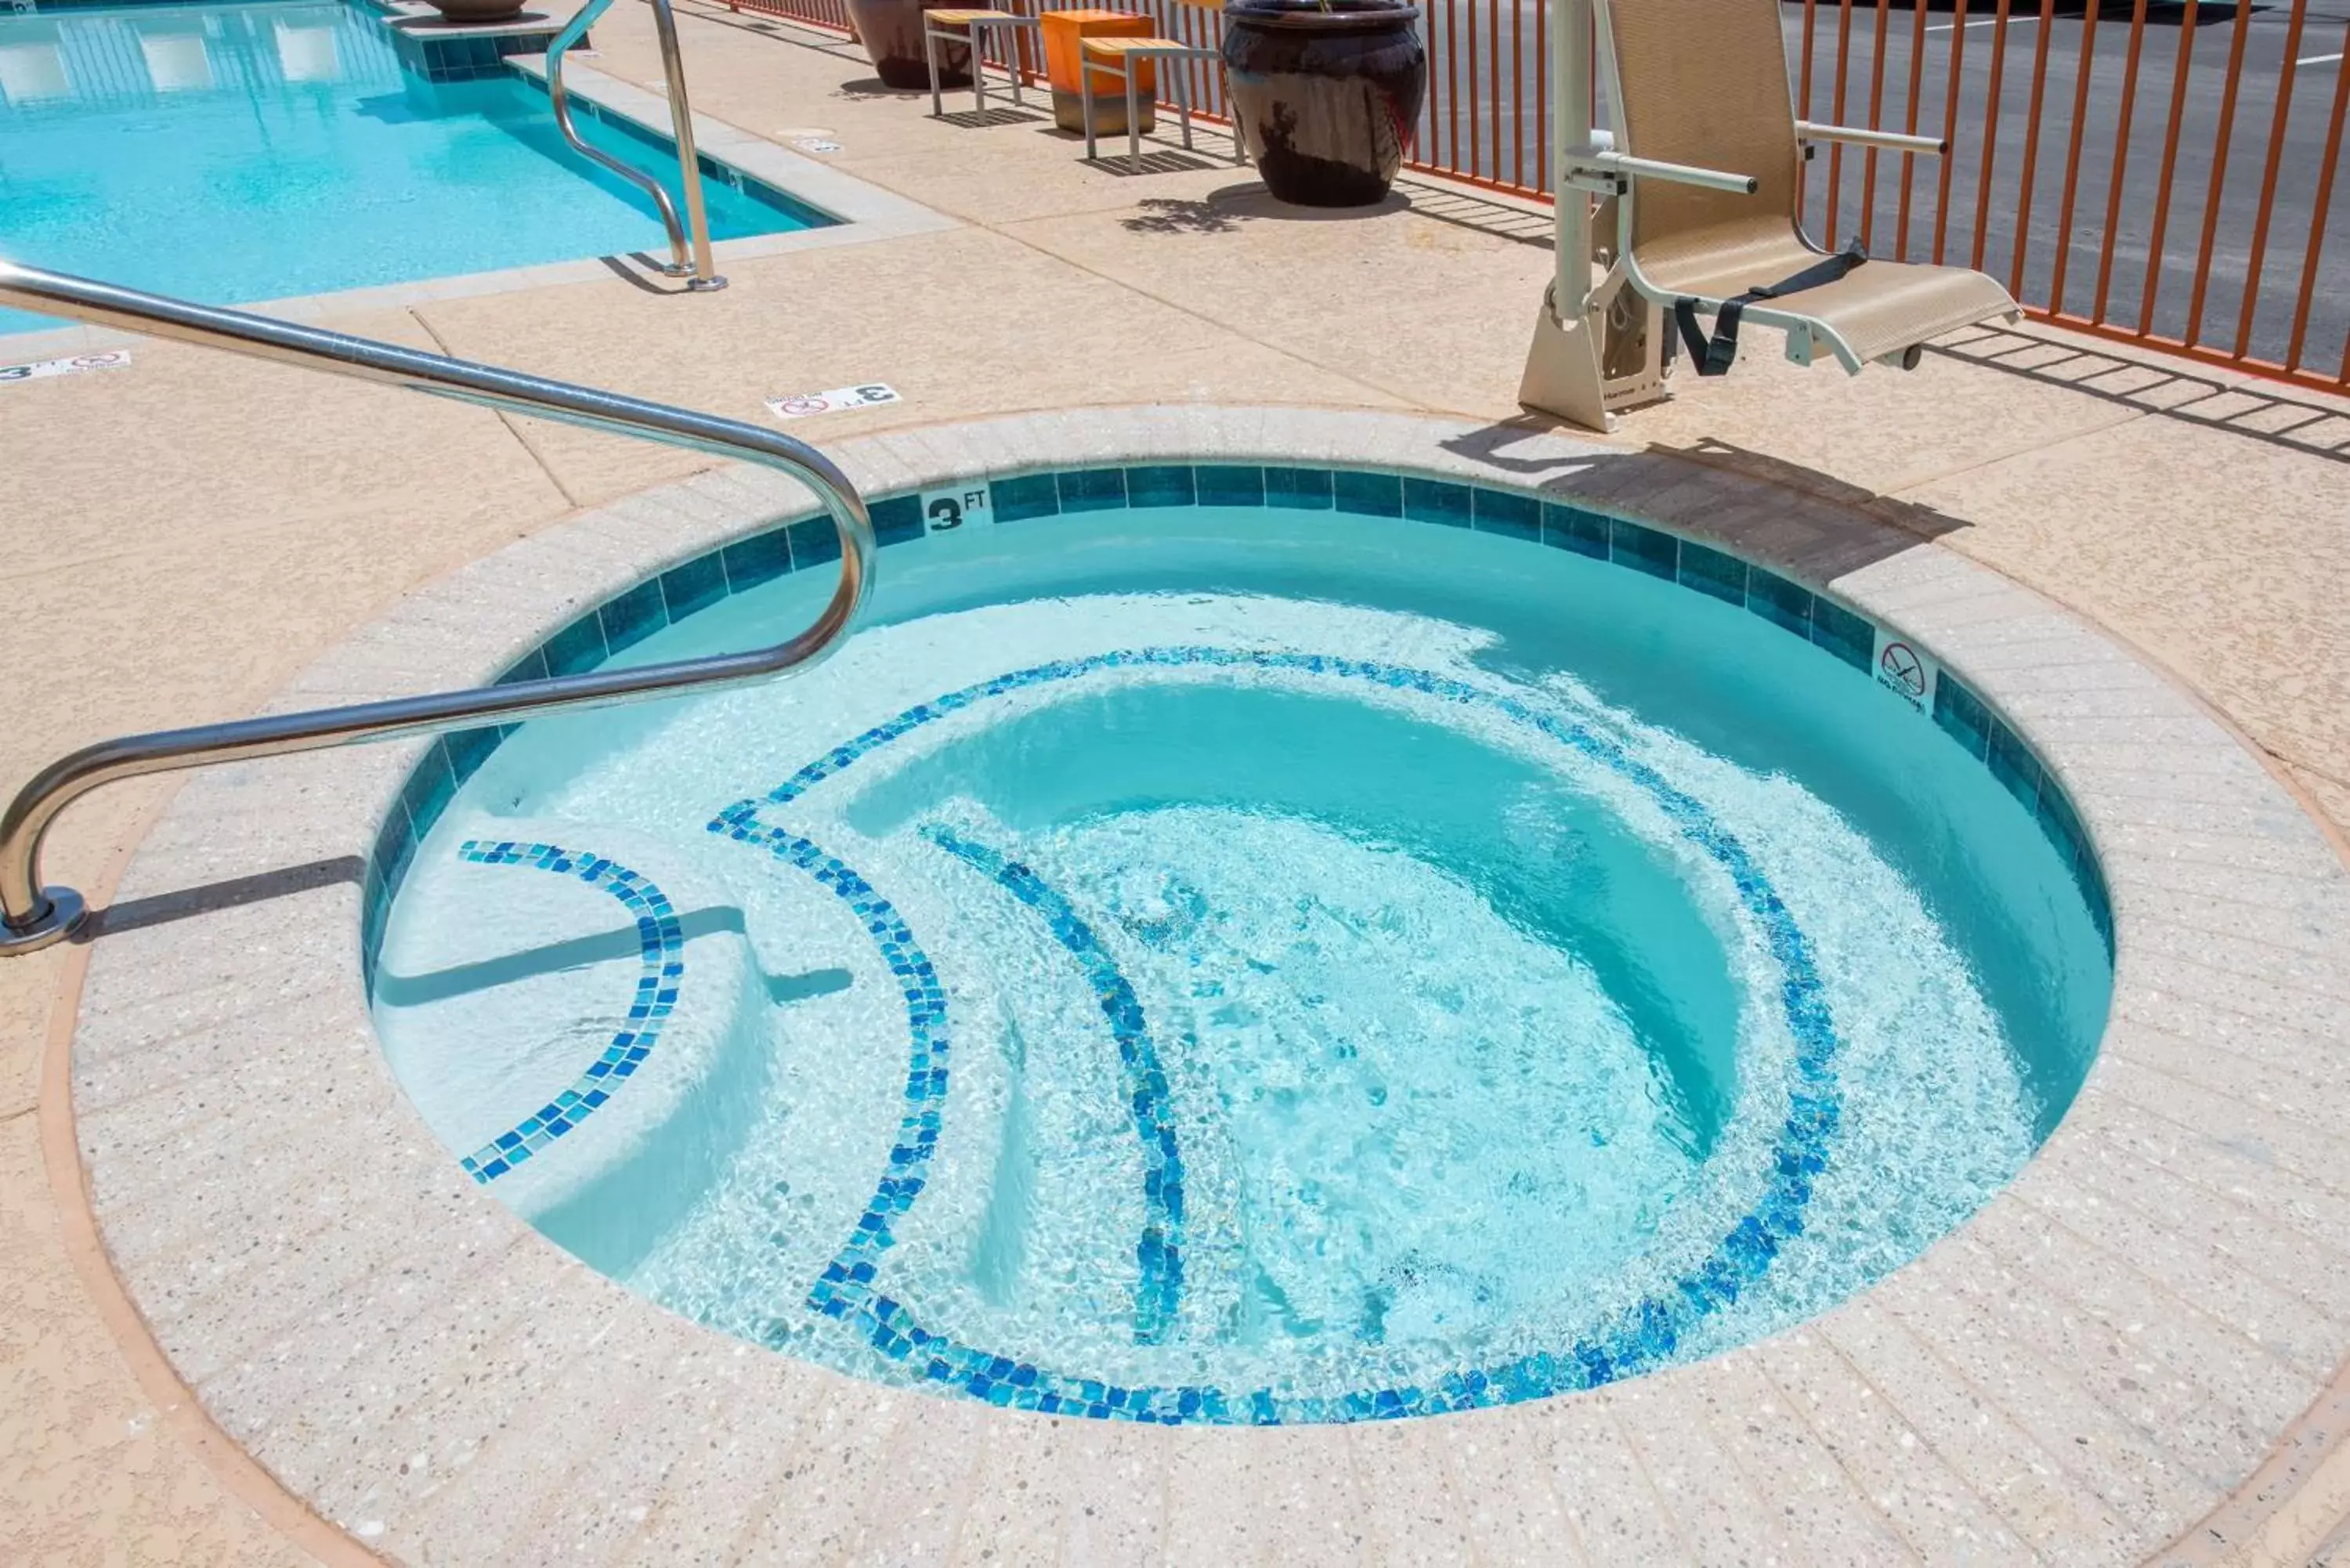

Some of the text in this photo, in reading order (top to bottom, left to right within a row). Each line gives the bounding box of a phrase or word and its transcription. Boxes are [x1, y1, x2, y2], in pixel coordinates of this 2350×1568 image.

[855, 386, 895, 401] 3
[928, 490, 985, 530] 3 FT
